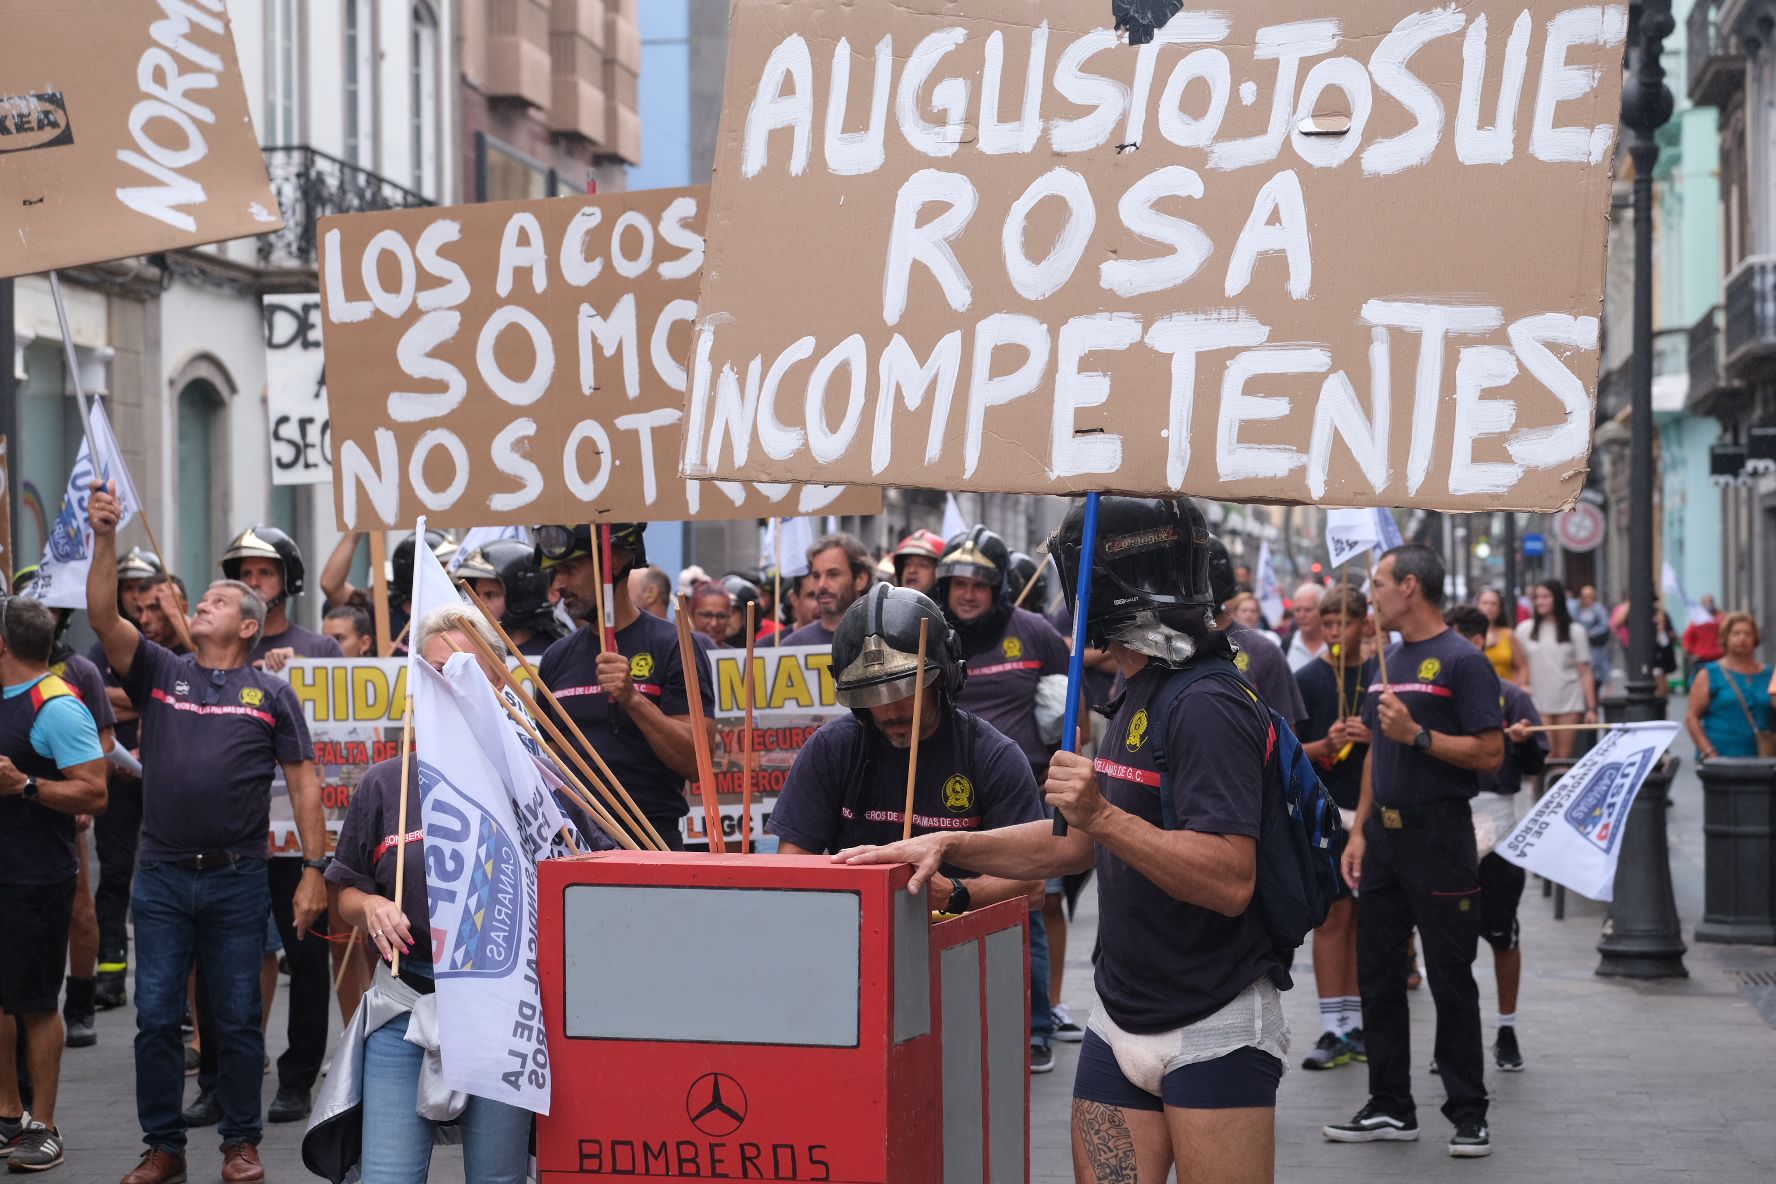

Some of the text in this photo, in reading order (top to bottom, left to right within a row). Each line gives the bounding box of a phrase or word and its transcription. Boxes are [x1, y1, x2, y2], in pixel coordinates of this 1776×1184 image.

[116, 0, 225, 233] NORM
[325, 219, 471, 324] LOS
[883, 165, 1311, 326] ROSA
[680, 297, 1598, 500] INCOMPETENTES
[313, 741, 369, 766] FALTA
[578, 1138, 831, 1182] BOMBEROS
